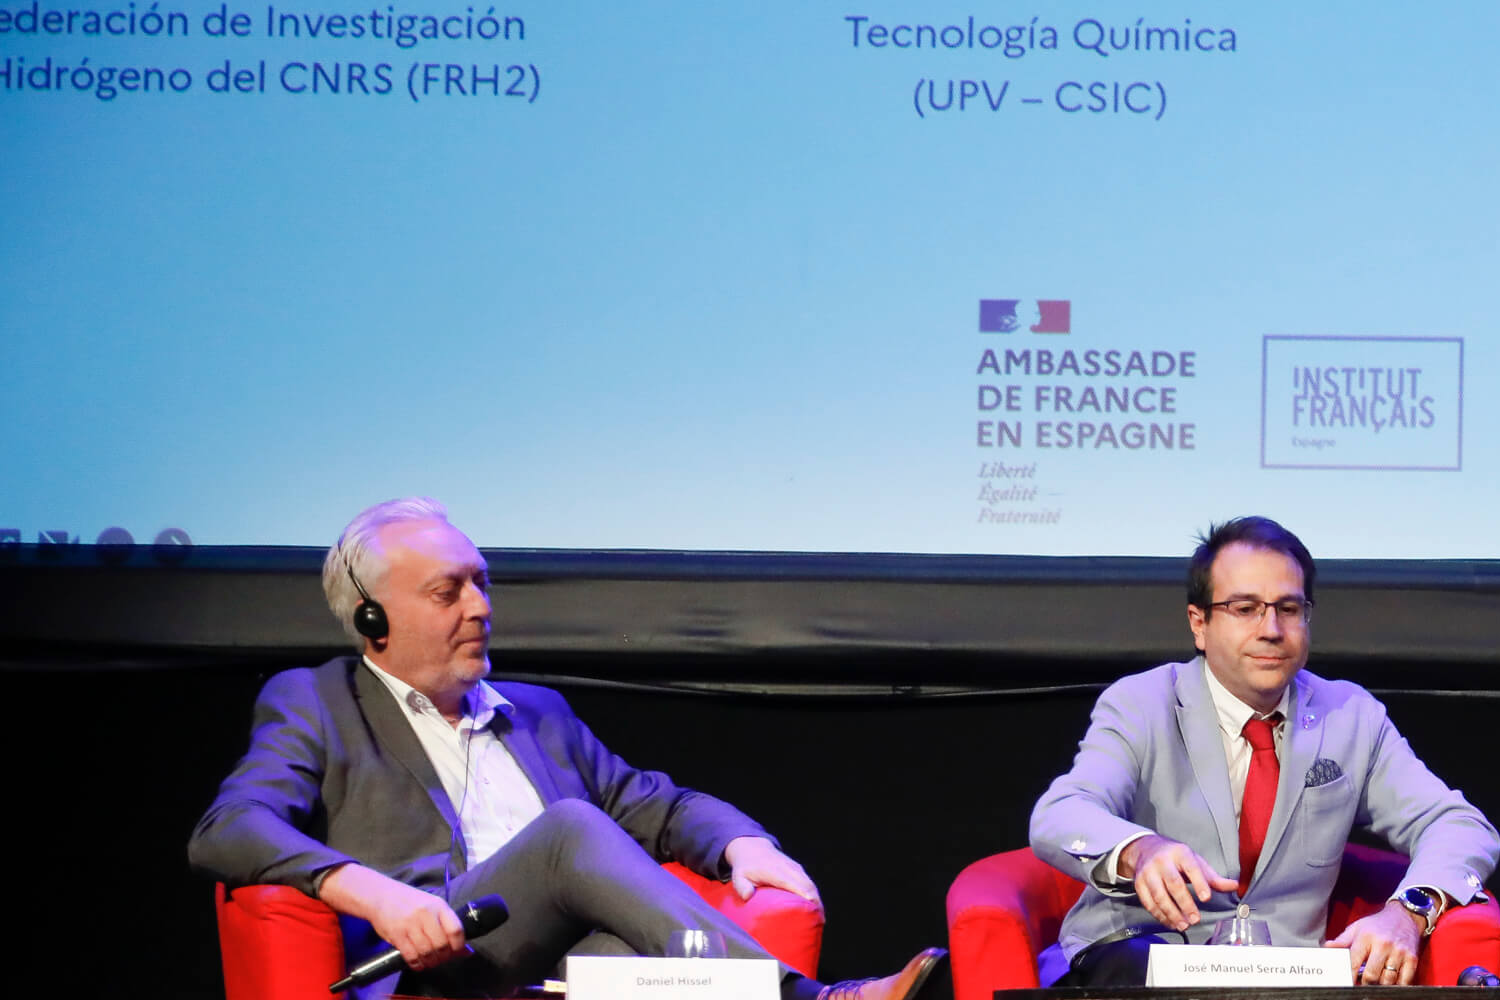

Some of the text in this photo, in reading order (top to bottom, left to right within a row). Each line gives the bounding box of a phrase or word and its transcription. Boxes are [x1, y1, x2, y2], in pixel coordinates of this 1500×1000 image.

[203, 3, 251, 38] de
[268, 5, 525, 50] Investigación
[844, 16, 1236, 59] Tecnología Química
[206, 60, 265, 94] del
[280, 63, 392, 95] CNRS
[408, 63, 540, 104] (FRH2)
[914, 79, 1009, 118] (UPV
[1055, 82, 1166, 120] CSIC)
[977, 349, 1196, 378] AMBASSADE
[1292, 366, 1423, 401] INSTITUT
[978, 385, 1177, 413] DE FRANCE
[977, 421, 1196, 450] EN ESPAGNE
[977, 461, 1037, 479] Liberté
[977, 481, 1038, 504] Égalité
[977, 507, 1062, 525] Fraternité
[636, 976, 712, 988] Daniel Hissel
[1183, 962, 1324, 976] José Manuel Serra Alfaro
